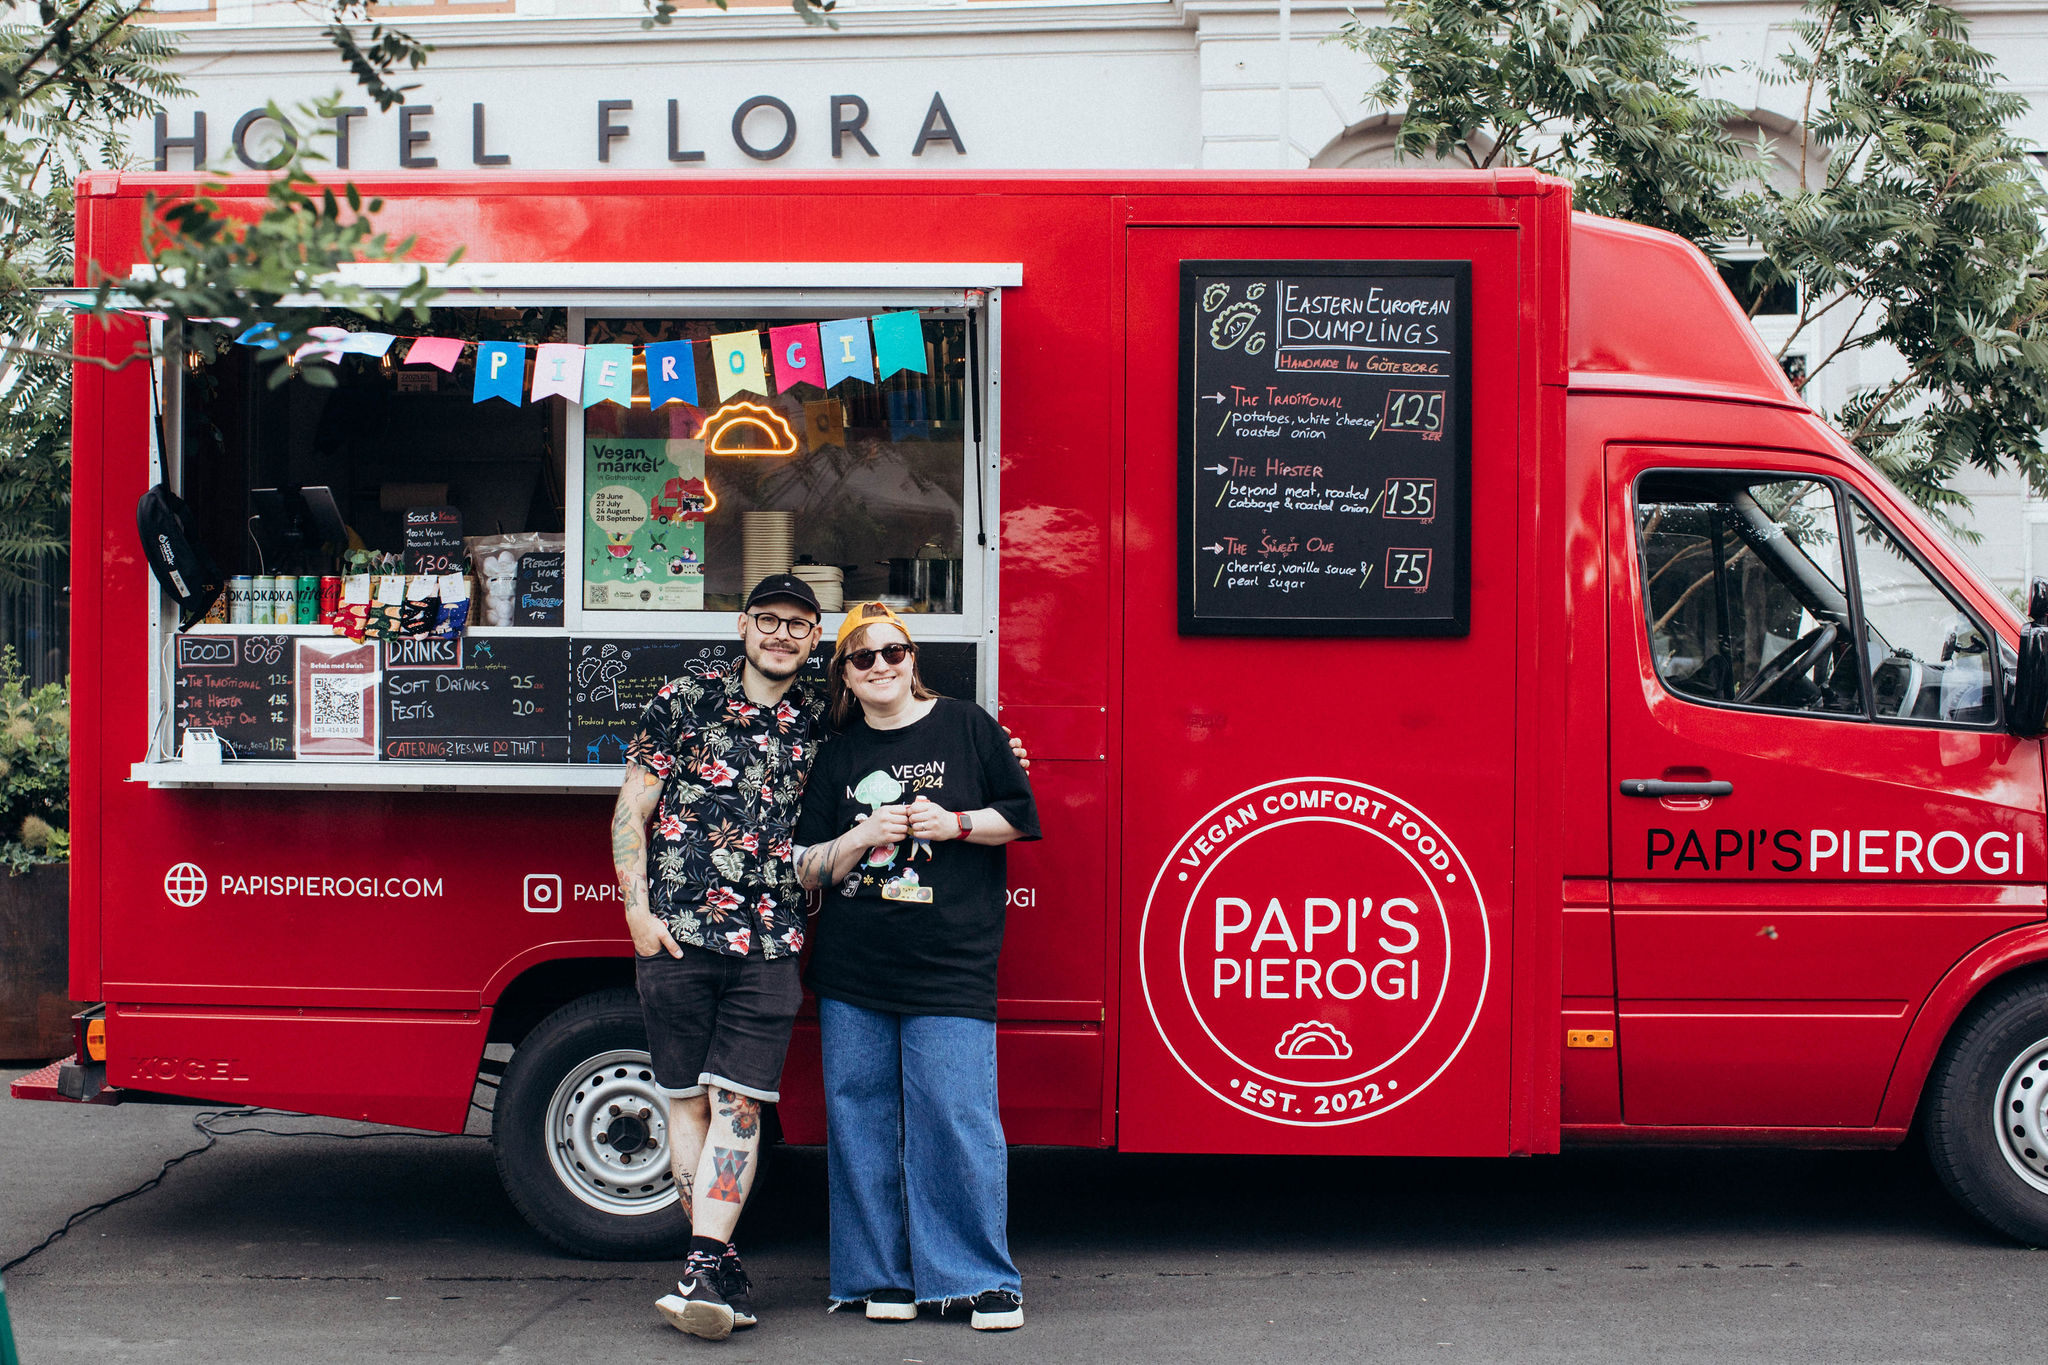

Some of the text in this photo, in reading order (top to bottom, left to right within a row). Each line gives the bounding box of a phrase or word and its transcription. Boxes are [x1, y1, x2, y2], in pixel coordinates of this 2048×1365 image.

[154, 91, 966, 171] HOTEL FLORA
[1285, 285, 1451, 316] EASTERN EUROPEAN
[1287, 317, 1439, 345] DUMPLINGS
[1280, 354, 1339, 369] HANDMADE
[1346, 354, 1359, 370] IN
[1230, 385, 1343, 409] THE TRADITIONAL
[1232, 411, 1294, 427] potatoes,
[1297, 414, 1330, 425] white
[1390, 393, 1442, 431] 125
[1235, 426, 1326, 439] roasted onion
[592, 444, 648, 463] Vegan
[597, 456, 665, 473] market
[1228, 456, 1324, 478] THE HIPSTER
[604, 474, 646, 482] Gothenburg
[1325, 486, 1369, 500] roasted
[1386, 480, 1434, 515] 135
[606, 500, 621, 508] July
[606, 508, 631, 516] August
[1340, 503, 1369, 514] onion
[606, 515, 645, 523] September
[1223, 532, 1335, 556] THE SWEET ONE
[415, 554, 448, 573] 130
[1324, 565, 1357, 576] sauce
[1394, 554, 1426, 585] 75
[1227, 577, 1306, 593] pearl sugar
[529, 611, 547, 620] 175
[182, 640, 231, 661] FOOD
[388, 639, 455, 665] DRINKS
[187, 674, 288, 690] THE TRADITIONAL 125
[388, 675, 430, 696] SOFT
[435, 674, 490, 692] DRINKS
[510, 675, 536, 689] 25
[187, 696, 202, 708] THE
[208, 694, 243, 708] HIPSTER
[390, 700, 435, 722] FESTIS
[512, 698, 535, 716] 20
[188, 714, 202, 727] THE
[239, 712, 257, 725] ONE
[577, 714, 604, 727] Produced
[269, 736, 287, 751] 175
[493, 741, 508, 753] DO
[891, 760, 945, 779] VEGAN
[912, 775, 944, 793] 2024
[1179, 789, 1450, 871] VEGAN COMFORT FOOD
[220, 875, 443, 898] PAPISPIEROGI.COM
[1214, 897, 1420, 954] PAPI'S
[1213, 958, 1419, 1001] PIEROGI
[1240, 1080, 1384, 1115] EST. 2022
